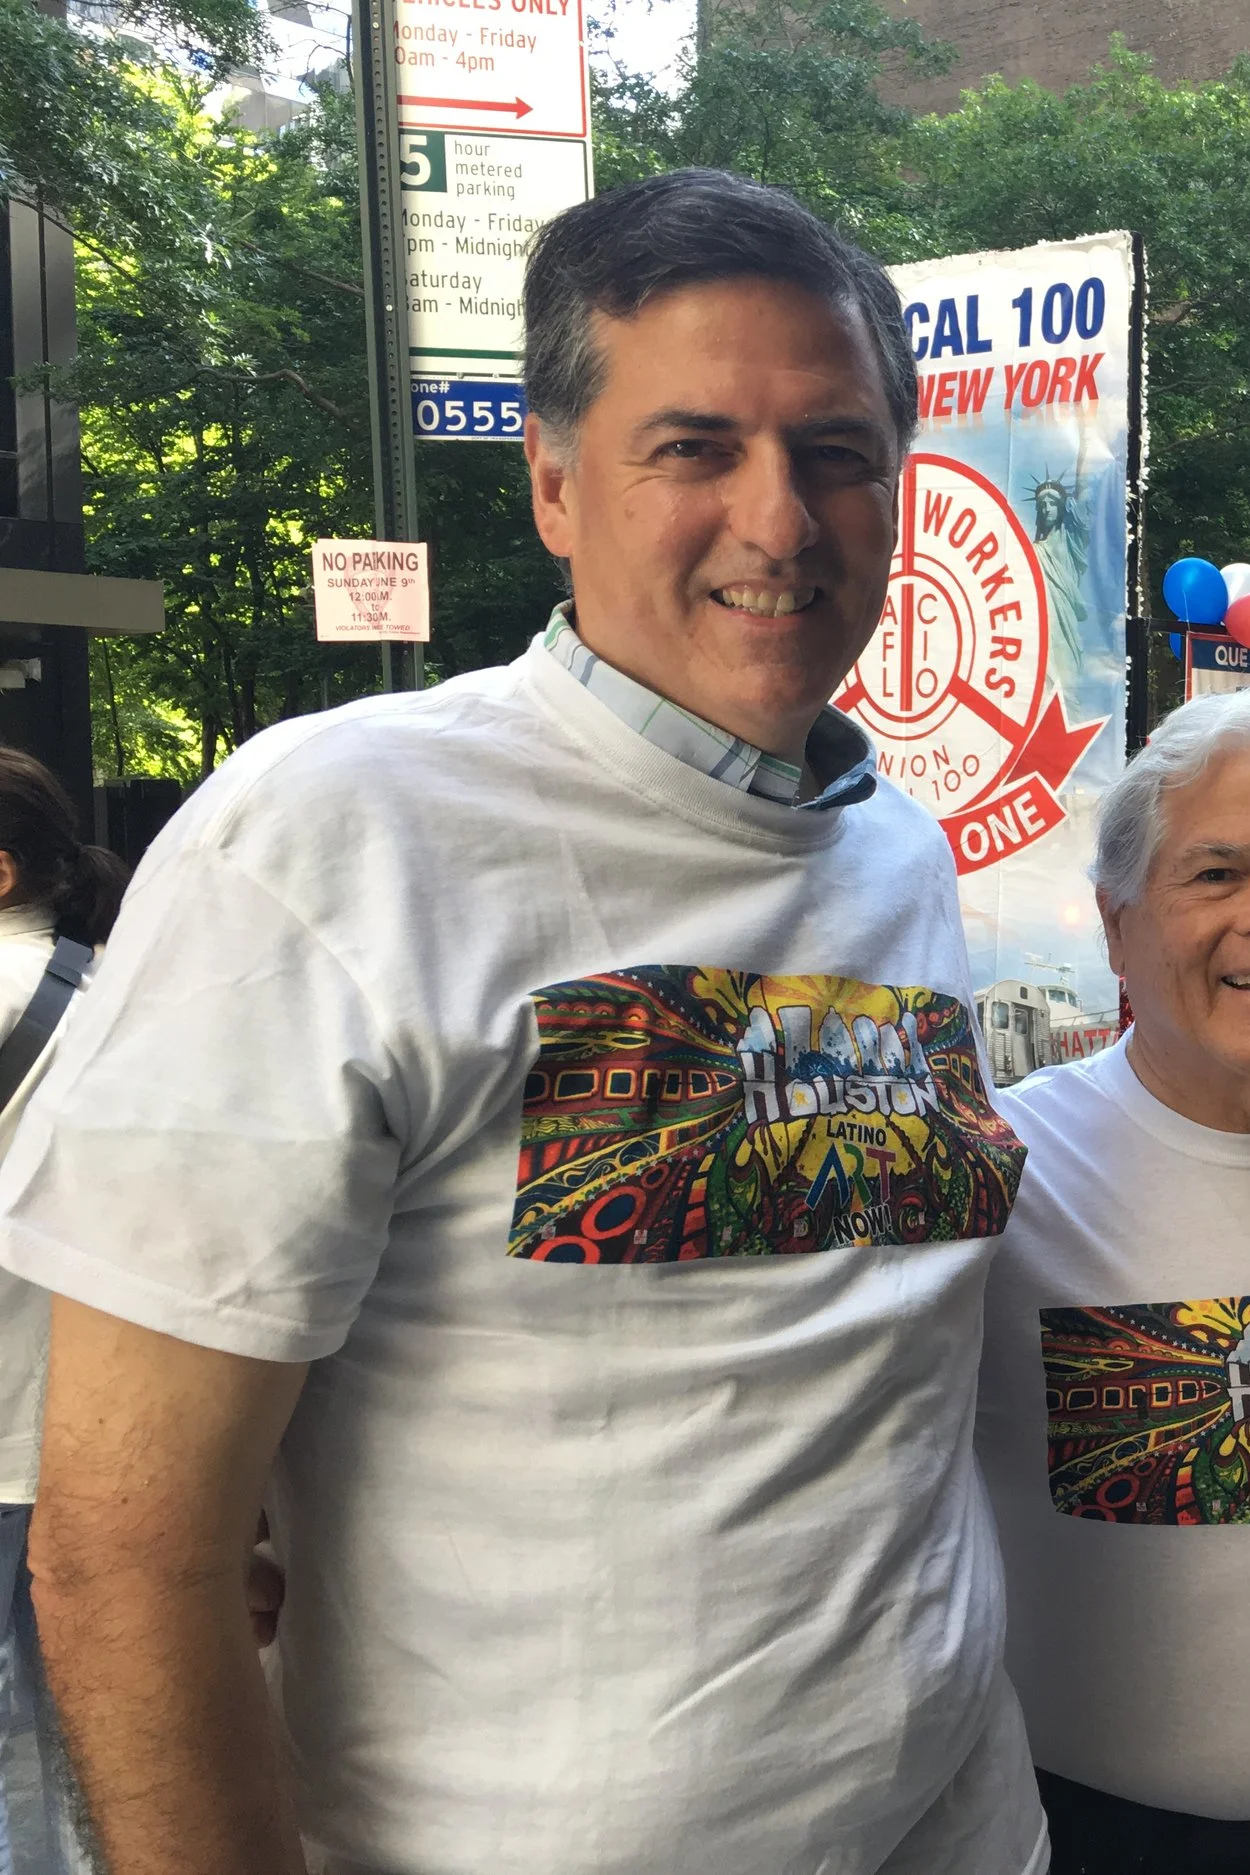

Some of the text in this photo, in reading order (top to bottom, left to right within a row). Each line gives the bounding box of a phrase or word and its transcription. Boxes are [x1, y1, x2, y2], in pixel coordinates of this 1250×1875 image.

[480, 27, 537, 53] Friday
[456, 51, 494, 73] 4pm
[455, 140, 490, 157] hour
[455, 161, 523, 178] metered
[457, 181, 515, 200] parking
[403, 234, 434, 256] pm
[405, 270, 482, 294] aturday
[459, 297, 526, 320] Midnigh
[1011, 277, 1106, 347] 100
[916, 352, 1105, 420] NEW YORK
[416, 399, 523, 433] 0555
[322, 552, 347, 571] NO
[327, 578, 374, 588] SUNDAY
[922, 488, 1024, 698] WORKERS
[371, 603, 380, 612] to
[1214, 645, 1248, 667] QUE
[931, 754, 980, 801] 100
[959, 789, 1047, 862] ONE
[826, 1118, 887, 1148] LATINO
[804, 1142, 898, 1213] ART
[831, 1204, 892, 1245] NOW!
